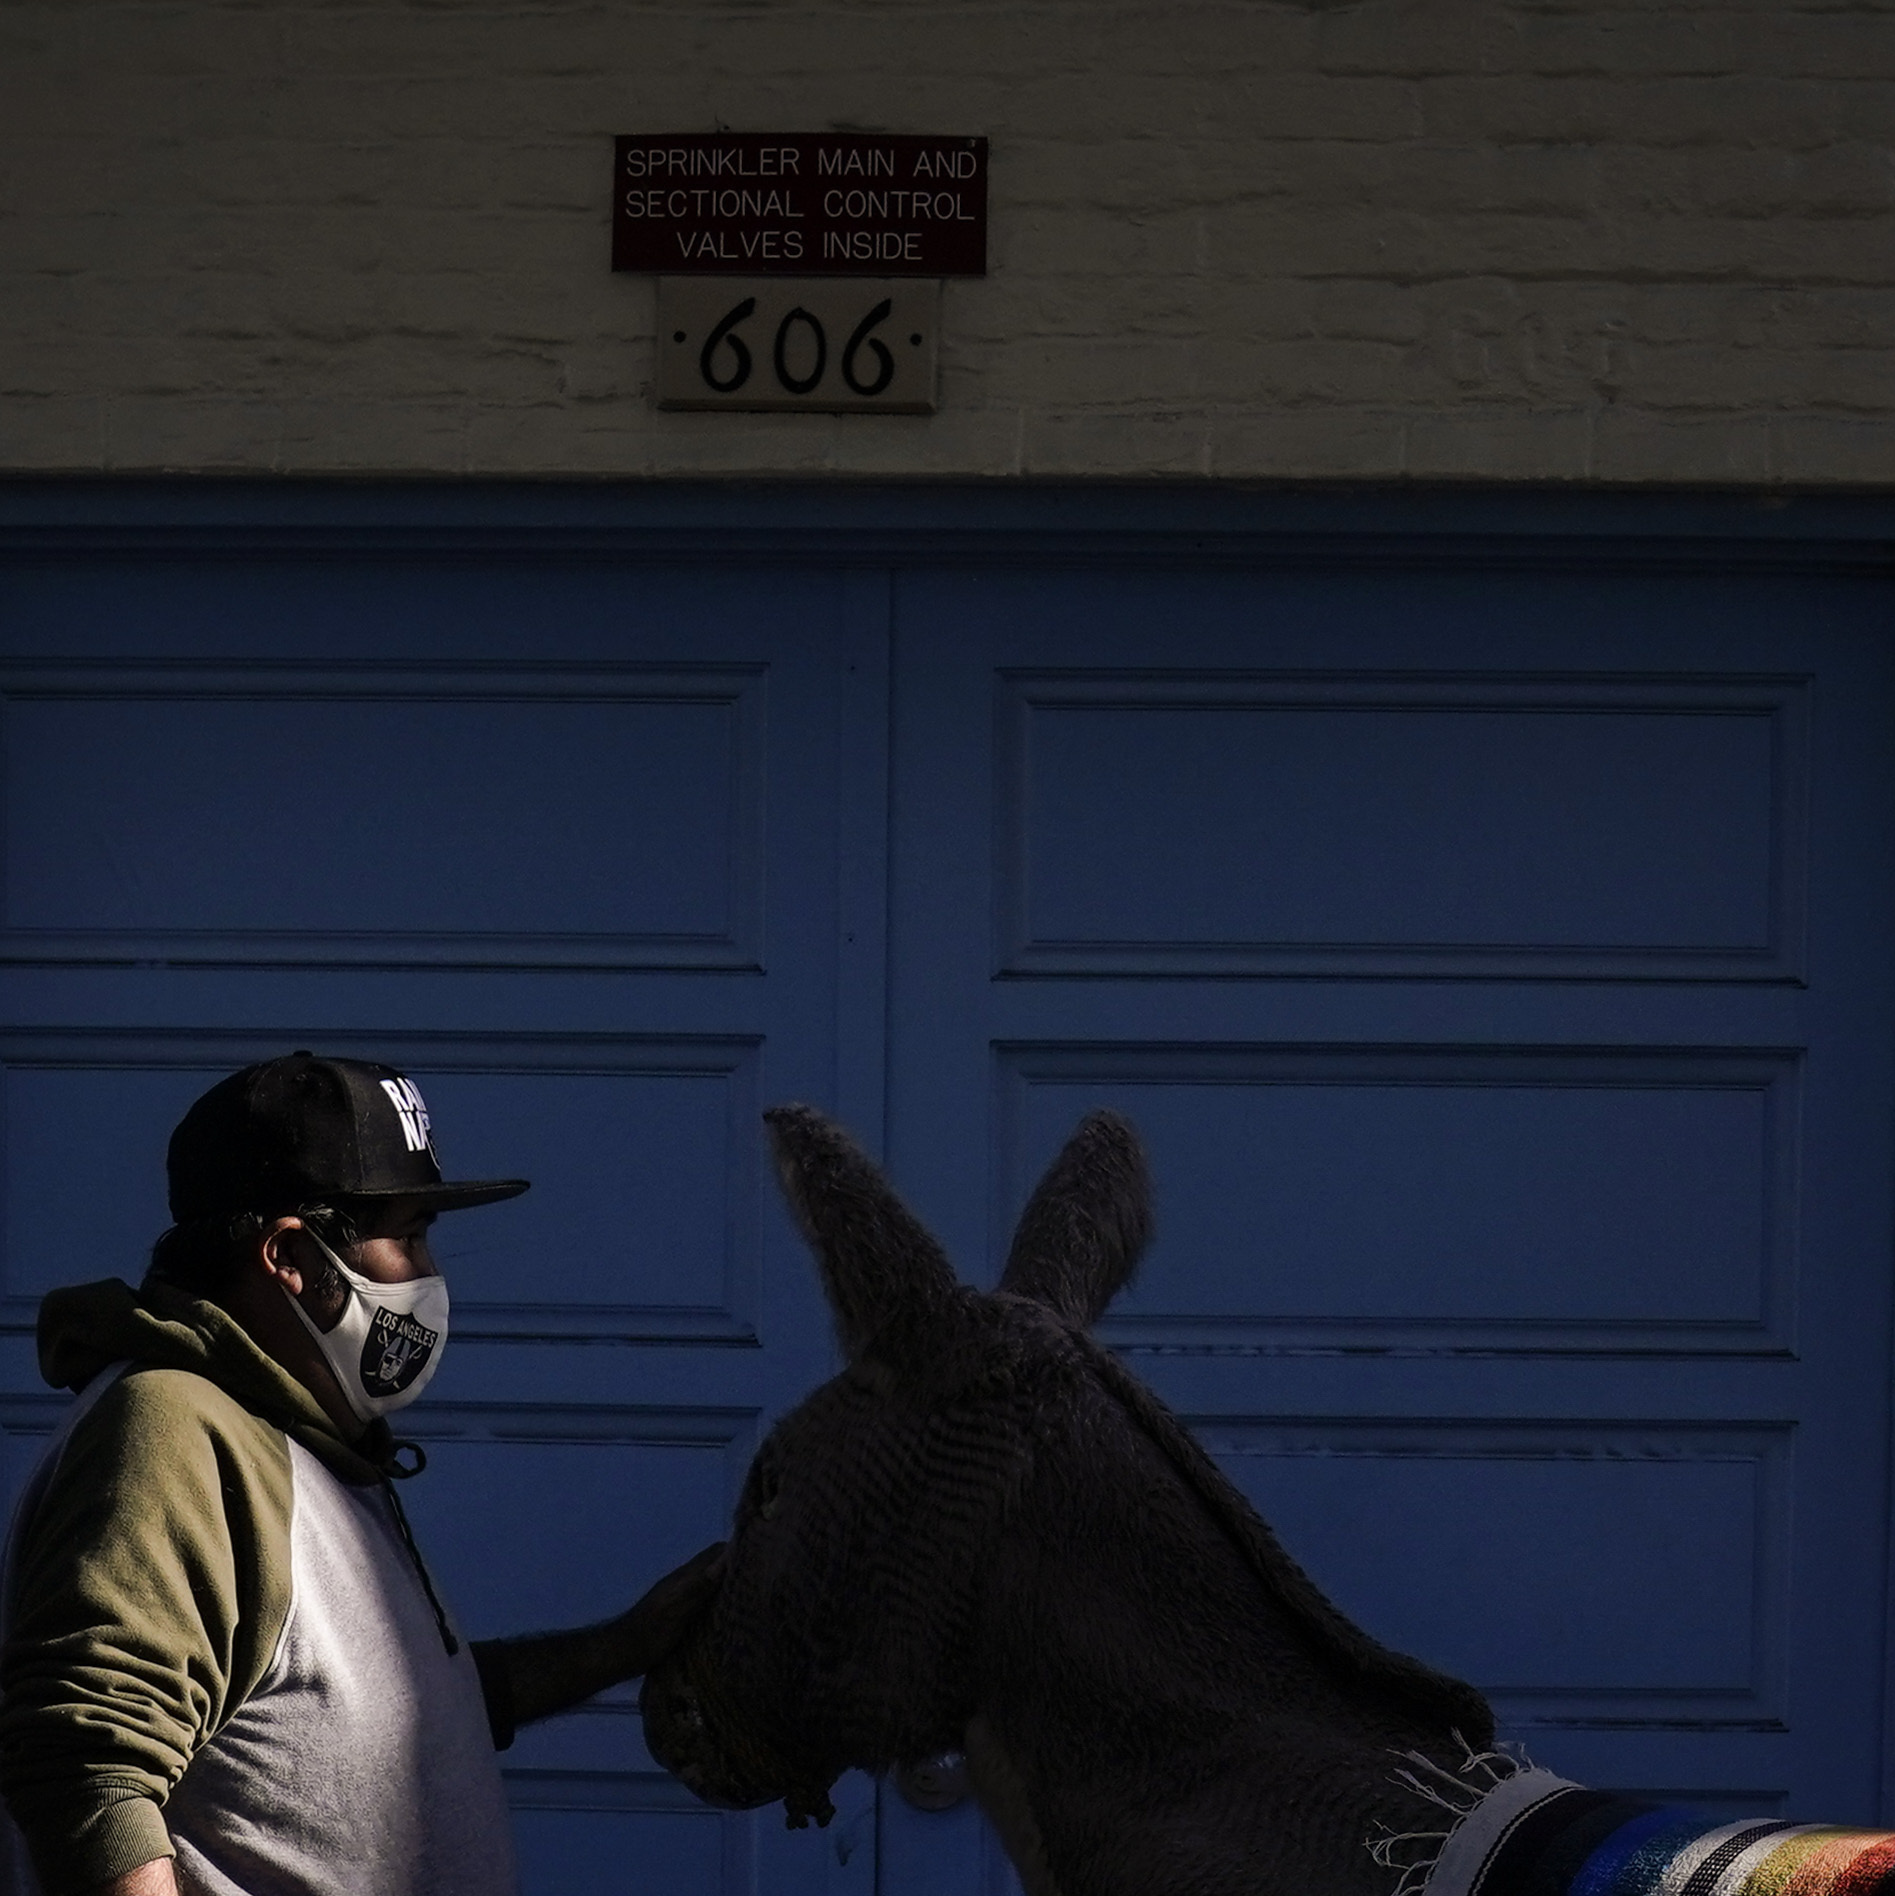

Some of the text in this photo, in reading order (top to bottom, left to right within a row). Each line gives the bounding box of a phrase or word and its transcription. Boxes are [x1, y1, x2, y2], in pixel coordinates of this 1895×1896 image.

[625, 148, 978, 180] SPRINKLER MAIN AND
[624, 190, 976, 221] SECTIONAL CONTROL
[676, 231, 924, 261] VALVES INSIDE
[700, 297, 895, 396] 606
[375, 1308, 436, 1348] LOS ANGELES
